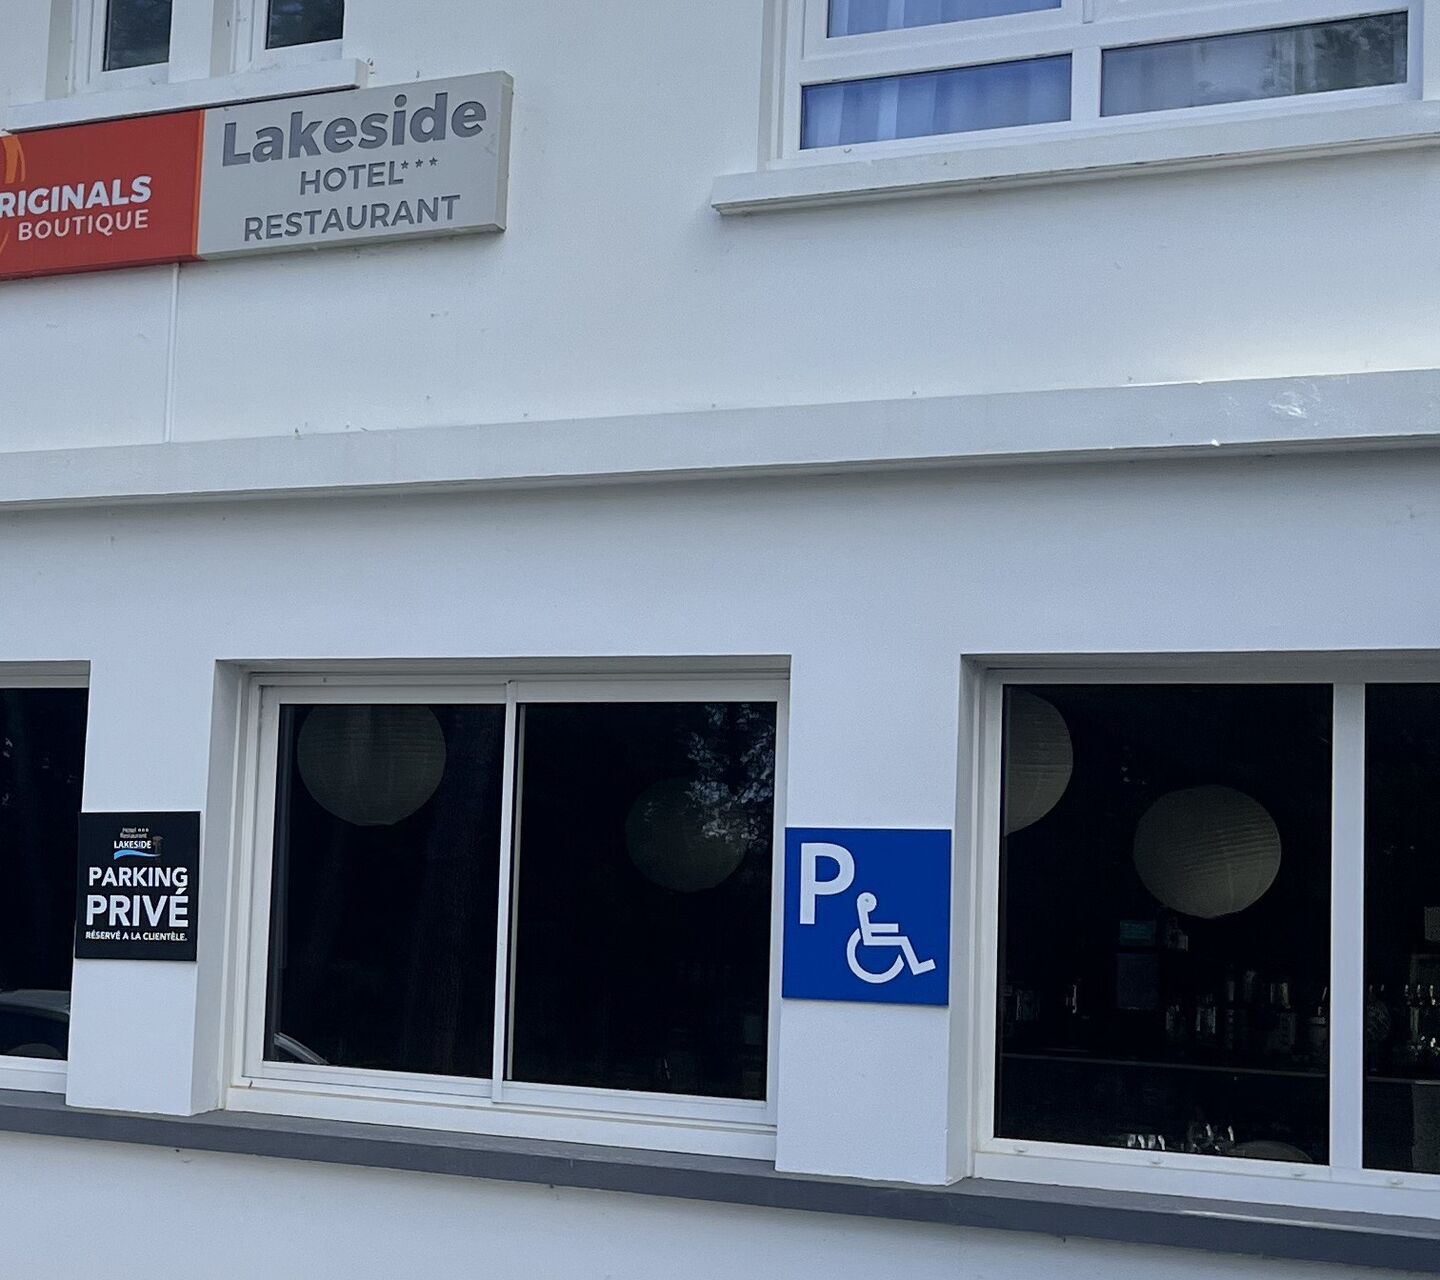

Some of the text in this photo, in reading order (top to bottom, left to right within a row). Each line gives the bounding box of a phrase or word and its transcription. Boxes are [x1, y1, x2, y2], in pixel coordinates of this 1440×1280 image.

[222, 91, 487, 167] Lakeside
[18, 208, 150, 242] BOUTIQUE
[244, 195, 461, 242] RESTAURANT
[114, 840, 152, 849] LAKESIDE
[89, 867, 188, 887] PARKING
[800, 842, 855, 924] P
[86, 887, 189, 927] PRIVÉ
[85, 929, 121, 940] RÉSERVÉ
[131, 931, 141, 940] LA
